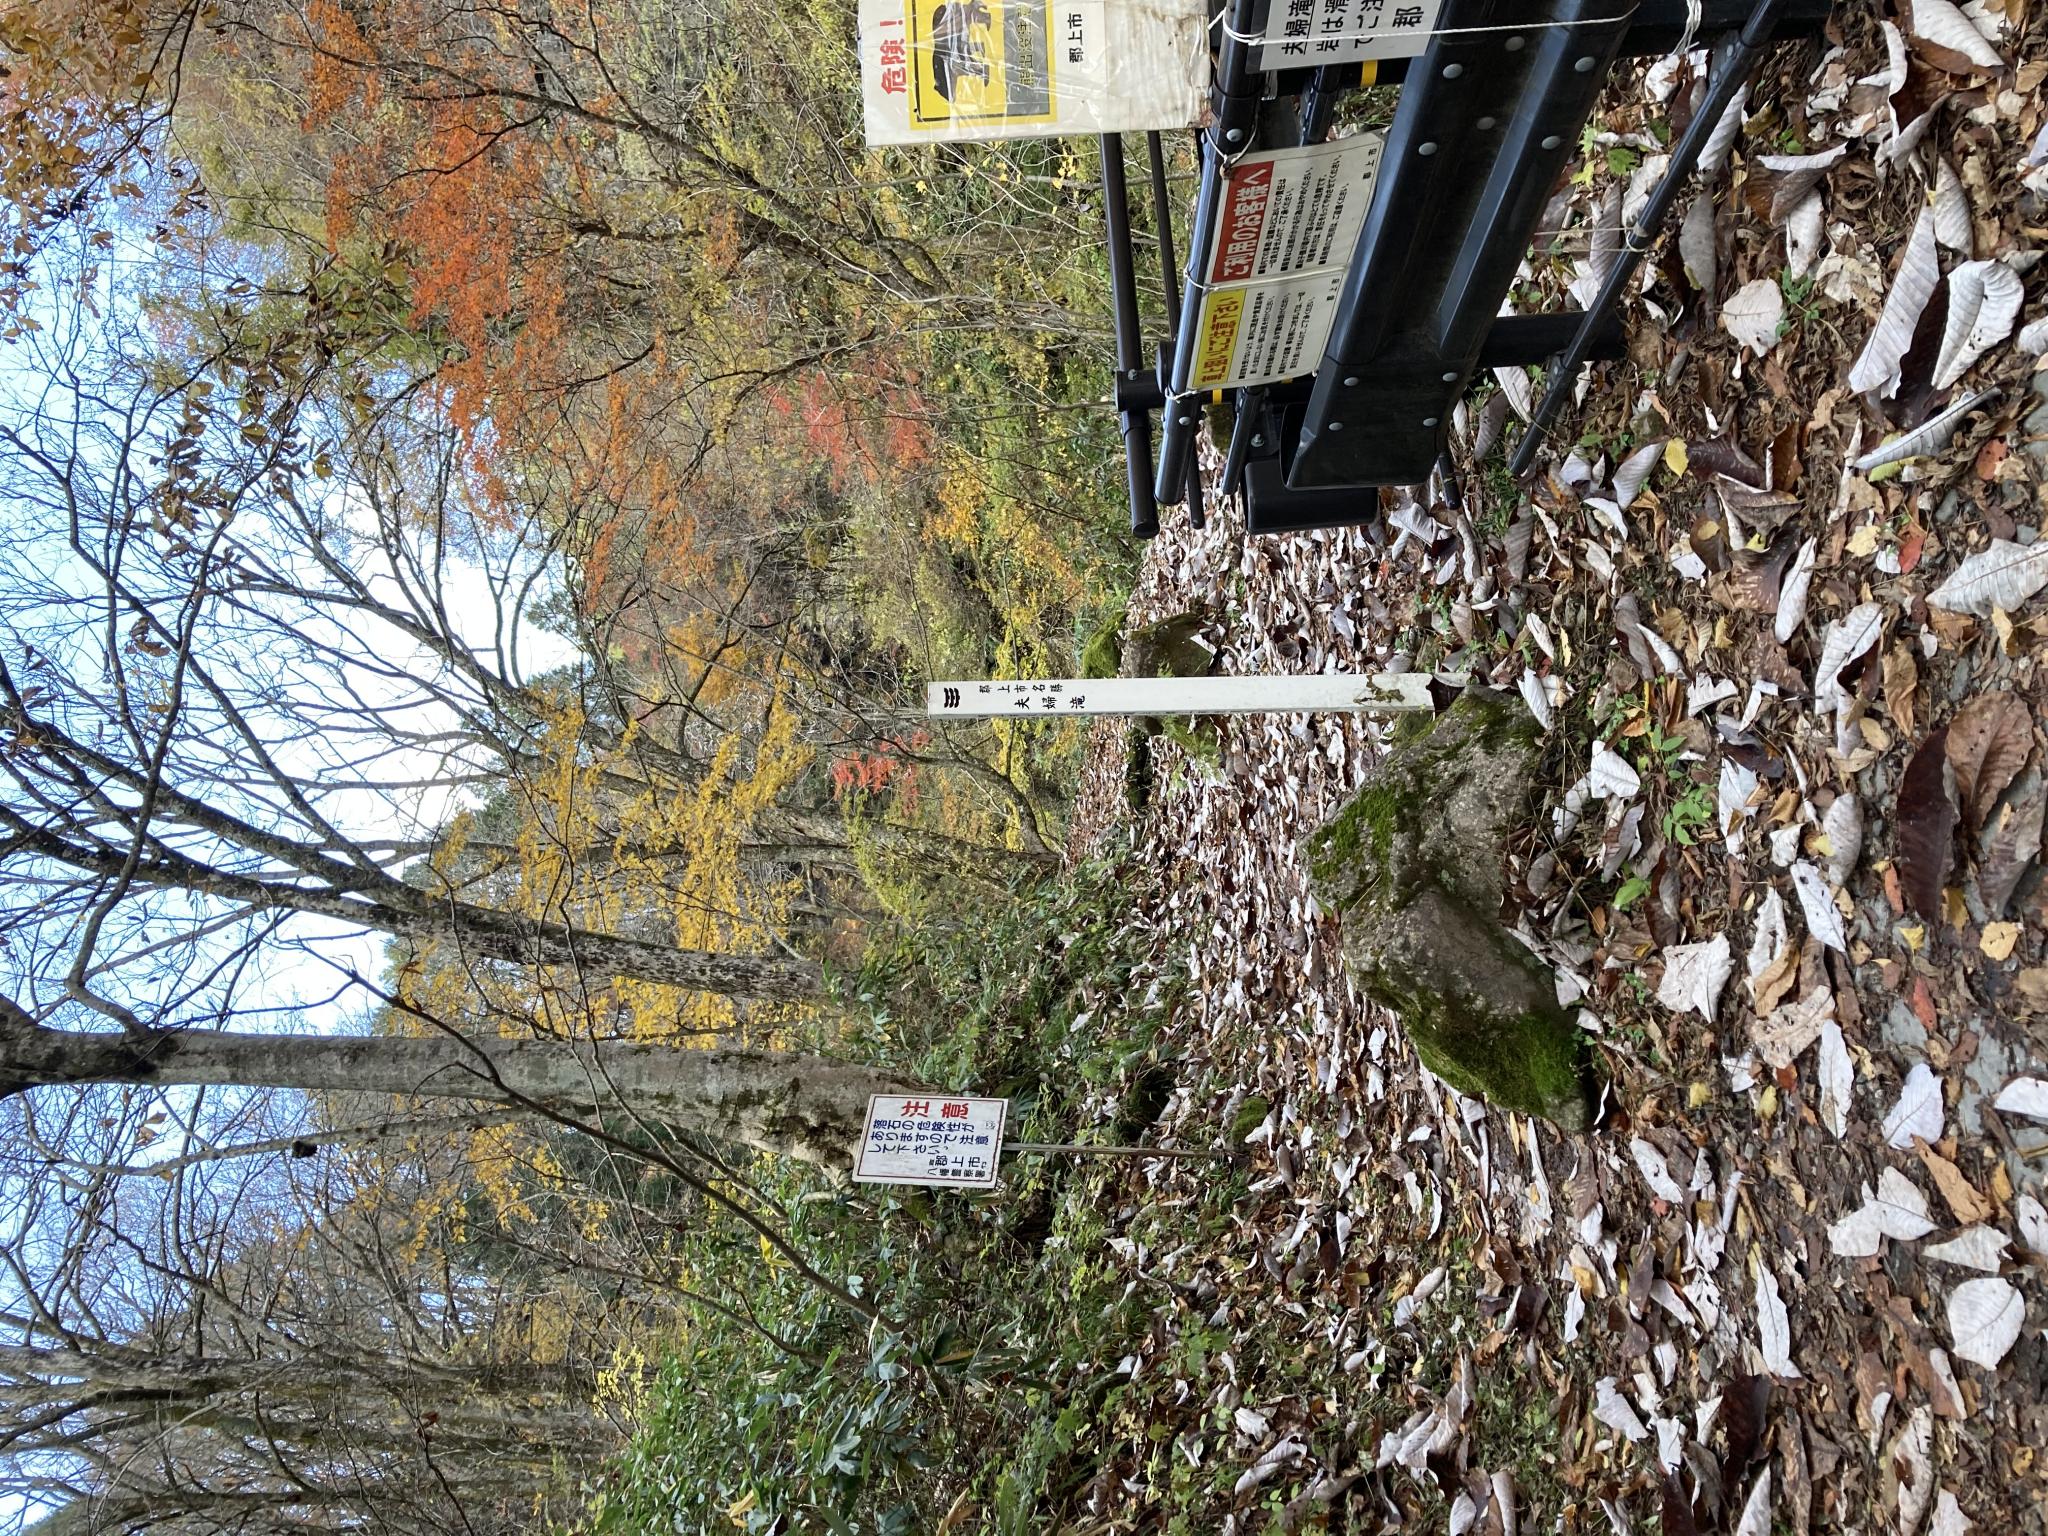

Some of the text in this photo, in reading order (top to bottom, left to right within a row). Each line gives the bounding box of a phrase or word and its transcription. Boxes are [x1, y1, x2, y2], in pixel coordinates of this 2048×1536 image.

[1392, 6, 1424, 28] 郡
[1068, 13, 1083, 63] 郡上市
[1223, 169, 1268, 276] ご利用のお客様へ
[1201, 297, 1238, 382] 車上狙いにご注意下さい
[979, 684, 1063, 693] 郡上市名勝
[1015, 696, 1086, 709] 夫婦滝
[901, 1100, 969, 1119] 注意
[873, 1119, 974, 1132] 落石の危険性が
[871, 1131, 988, 1145] ありますので注意
[868, 1143, 949, 1154] して下さい。
